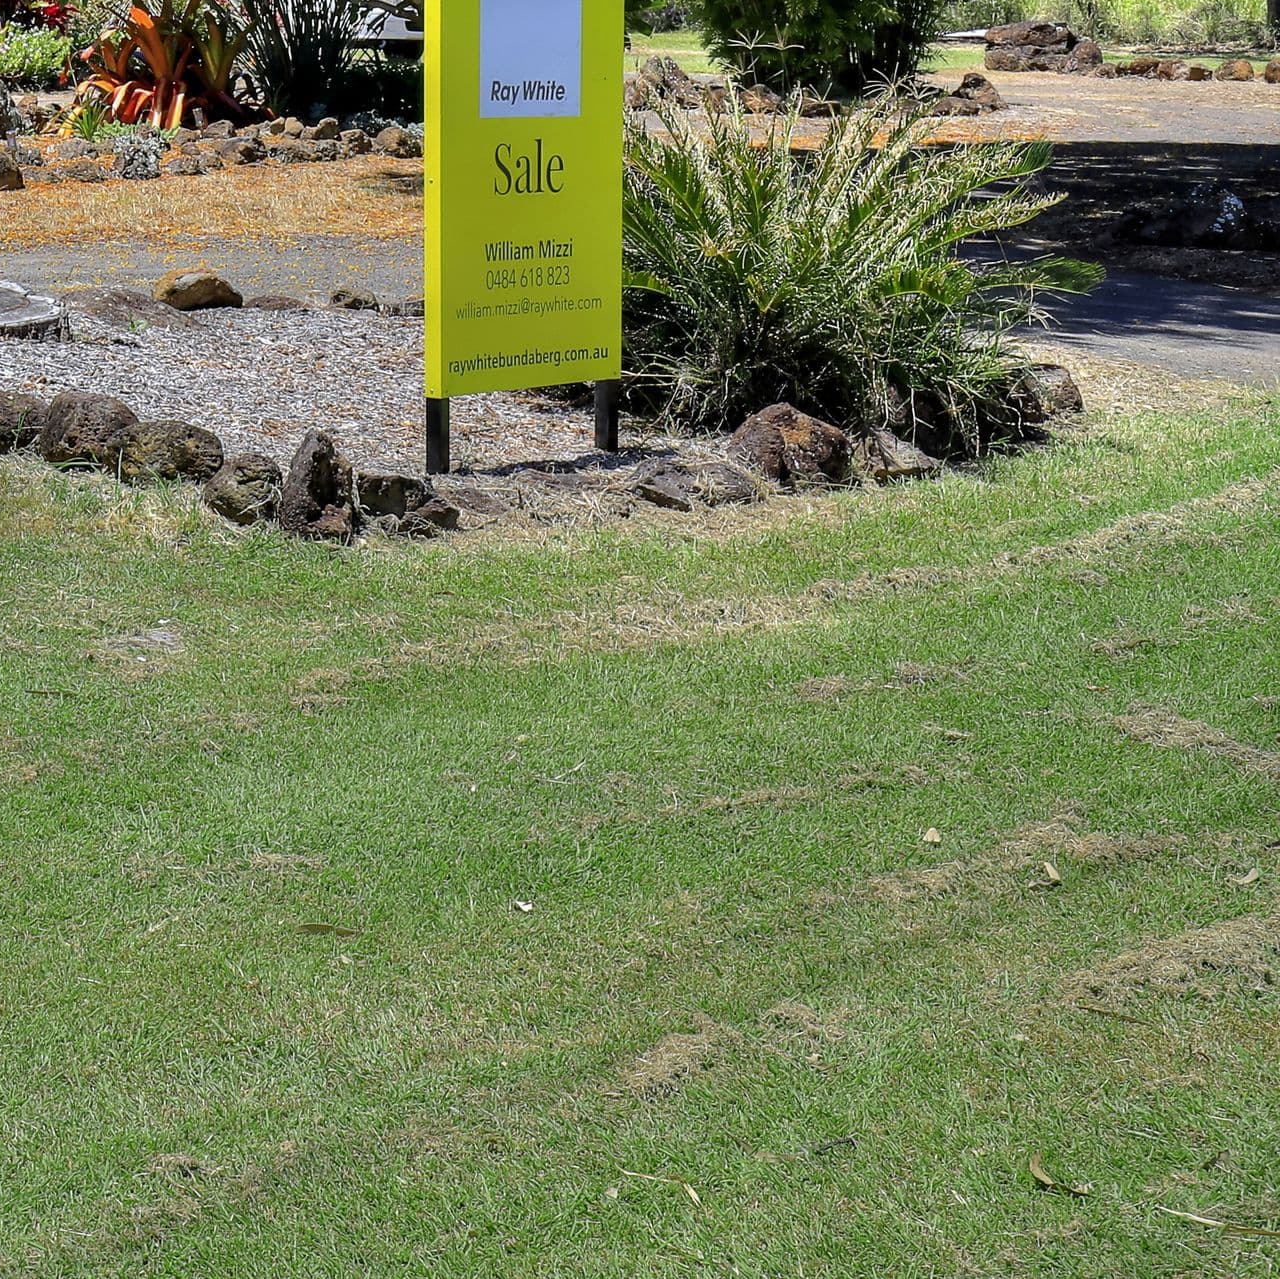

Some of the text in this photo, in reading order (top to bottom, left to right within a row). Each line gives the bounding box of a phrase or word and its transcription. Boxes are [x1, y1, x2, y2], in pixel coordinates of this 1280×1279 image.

[491, 80, 565, 105] Ray White
[494, 139, 564, 195] Sale
[485, 238, 573, 262] William Mizzi
[486, 266, 570, 290] 0484 618 823
[456, 296, 602, 319] william.mizzi@raywhite.com
[448, 346, 609, 376] raywhitebundaberg.com.au
